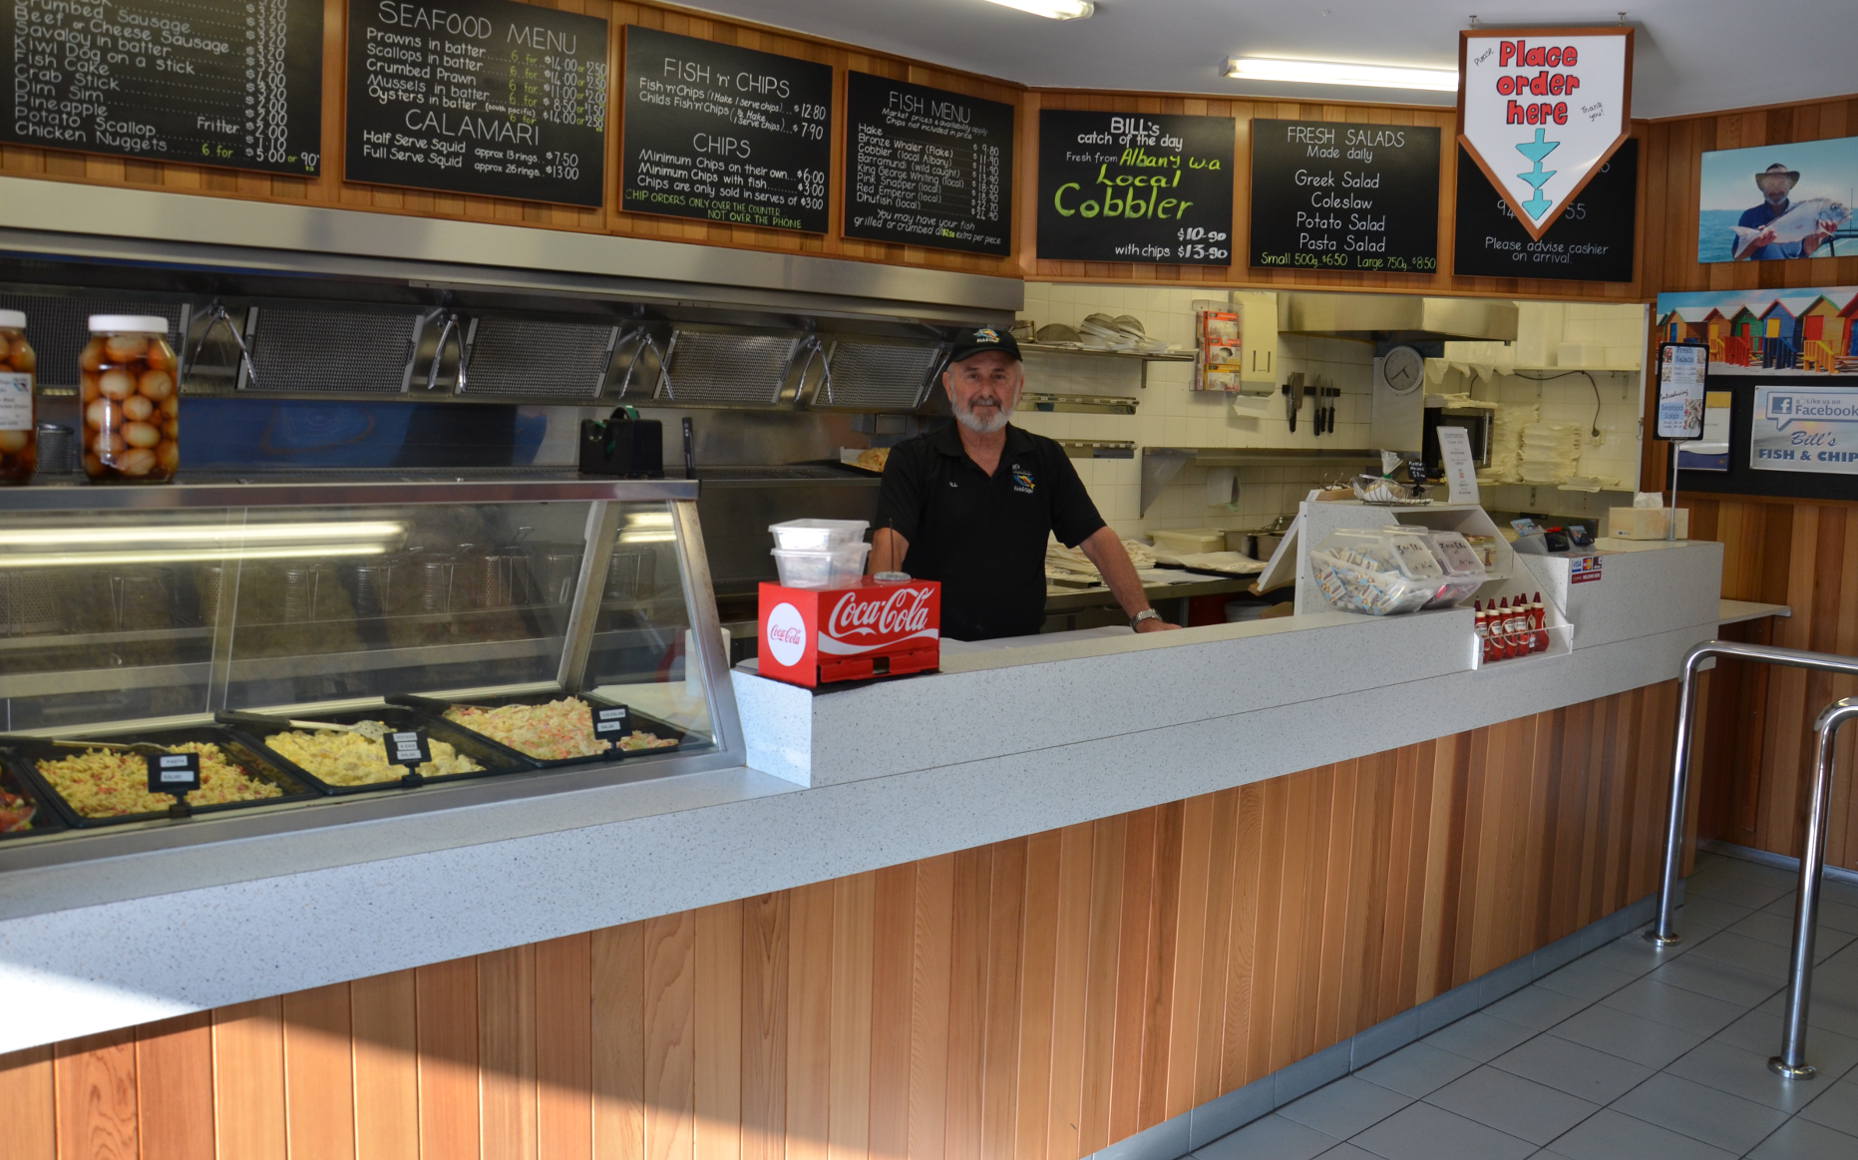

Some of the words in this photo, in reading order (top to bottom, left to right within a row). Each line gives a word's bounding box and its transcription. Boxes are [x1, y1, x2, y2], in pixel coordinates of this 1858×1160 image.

[14, 5, 63, 26] Beef
[90, 19, 152, 40] Cheese
[161, 31, 230, 54] Sausage
[118, 10, 191, 34] Sausage
[378, 0, 492, 39] SEAFOOD
[507, 23, 576, 55] MENU
[16, 21, 91, 48] Savaloy
[118, 38, 171, 57] batter
[367, 27, 421, 47] Prawns
[429, 38, 440, 51] in
[445, 41, 486, 57] batter
[15, 35, 57, 54] Kiwi
[66, 42, 101, 64] Dog
[107, 52, 130, 65] on
[156, 58, 195, 74] stick
[15, 49, 57, 68] Fish
[64, 57, 110, 76] Cake
[367, 43, 422, 63] Scallops
[428, 52, 439, 65] in
[444, 56, 484, 71] batter
[1499, 40, 1577, 67] Place
[15, 64, 62, 83] Crab
[75, 72, 120, 91] Stick
[367, 59, 430, 78] Crumbed
[437, 68, 476, 86] Prawn
[664, 58, 709, 84] FISH
[737, 72, 789, 98] CHIPS
[1496, 71, 1580, 96] order
[15, 78, 56, 96] Dim
[69, 86, 104, 102] Sim
[367, 74, 426, 92] Mussels
[435, 83, 445, 94] in
[451, 86, 490, 100] batter
[369, 86, 424, 104] Oysters
[430, 95, 439, 105] in
[443, 97, 476, 110] batter
[640, 77, 663, 91] Fish
[677, 85, 704, 99] Chips
[740, 99, 760, 109] serve
[15, 93, 108, 120] Pineapple
[197, 117, 240, 133] Fritter
[640, 91, 670, 106] Childs
[674, 97, 693, 108] Fish
[703, 103, 729, 115] Chips
[889, 90, 924, 114] FISH
[932, 100, 971, 123] MENU
[1506, 100, 1568, 125] here
[15, 106, 80, 127] Potato
[96, 117, 155, 138] Scallop
[406, 109, 539, 145] CALAMARI
[858, 123, 883, 136] Hake
[1111, 116, 1160, 136] BILL's
[15, 122, 86, 142] Chicken
[96, 131, 167, 152] Nuggets
[363, 130, 390, 143] Half
[393, 133, 428, 149] Serve
[432, 139, 465, 154] Squid
[474, 148, 503, 159] approx
[693, 133, 750, 158] CHIPS
[858, 133, 890, 147] Bronze
[1078, 130, 1112, 144] catch
[1119, 133, 1131, 148] of
[1137, 133, 1156, 146] the
[1160, 134, 1183, 151] day
[1287, 126, 1335, 144] FRESH
[1345, 129, 1405, 147] SALADS
[363, 146, 387, 159] Full
[390, 149, 428, 162] Serve
[430, 153, 462, 169] Squid
[474, 163, 502, 173] approx
[857, 154, 907, 169] Barramundi
[858, 144, 892, 156] Cobbler
[1066, 151, 1092, 162] Fresh
[1094, 152, 1117, 162] from
[1119, 148, 1181, 168] Albany
[1306, 146, 1340, 158] Made
[1347, 147, 1373, 164] daily
[639, 149, 691, 166] Minimum
[697, 158, 724, 171] Chips
[729, 163, 741, 172] on
[745, 164, 767, 177] their
[857, 163, 876, 176] King
[639, 163, 688, 179] Minimum
[691, 170, 718, 183] Chips
[723, 173, 743, 185] with
[748, 176, 766, 188] fish
[857, 173, 876, 184] Pink
[881, 176, 916, 192] Snapper
[1096, 164, 1181, 187] Local
[1295, 169, 1335, 187] Greek
[1342, 171, 1380, 188] Salad
[637, 175, 669, 190] Chips
[674, 182, 690, 192] are
[694, 183, 715, 197] only
[720, 188, 739, 198] sold
[744, 188, 753, 198] in
[755, 192, 784, 204] serves
[857, 183, 874, 193] Red
[879, 185, 916, 201] Emperor
[1054, 182, 1193, 219] Cobbler
[1311, 191, 1372, 209] Coleslaw
[625, 189, 650, 201] CHIP
[651, 193, 686, 205] ORDERS
[689, 197, 709, 209] ONLY
[712, 200, 730, 210] OVER
[733, 202, 748, 212] THE
[749, 204, 781, 216] COUNTER
[708, 210, 725, 220] NOT
[730, 212, 751, 222] OVER
[755, 215, 770, 225] THE
[773, 218, 801, 229] PHONE
[854, 216, 882, 227] grilled
[897, 222, 933, 235] crumbed
[956, 230, 971, 240] extra
[973, 232, 983, 242] per
[878, 208, 891, 219] You
[894, 213, 913, 223] may
[916, 215, 936, 225] have
[939, 219, 958, 228] your
[961, 218, 975, 230] fish
[1297, 211, 1342, 229] Potato
[1349, 213, 1385, 231] Salad
[1115, 244, 1139, 256] with
[1142, 244, 1170, 260] chips
[1300, 233, 1336, 250] Pasta
[1344, 235, 1386, 252] Salad
[1485, 236, 1521, 251] Please
[1528, 239, 1566, 253] advise
[1568, 241, 1608, 255] cashier
[1261, 251, 1291, 265] Small
[1357, 255, 1384, 271] Large
[1512, 252, 1527, 262] on
[1795, 404, 1858, 416] Facebook
[1791, 431, 1838, 447] Bill's
[1759, 449, 1794, 460] FISH
[1800, 451, 1811, 461] &
[829, 588, 935, 638] Coca-Cola
